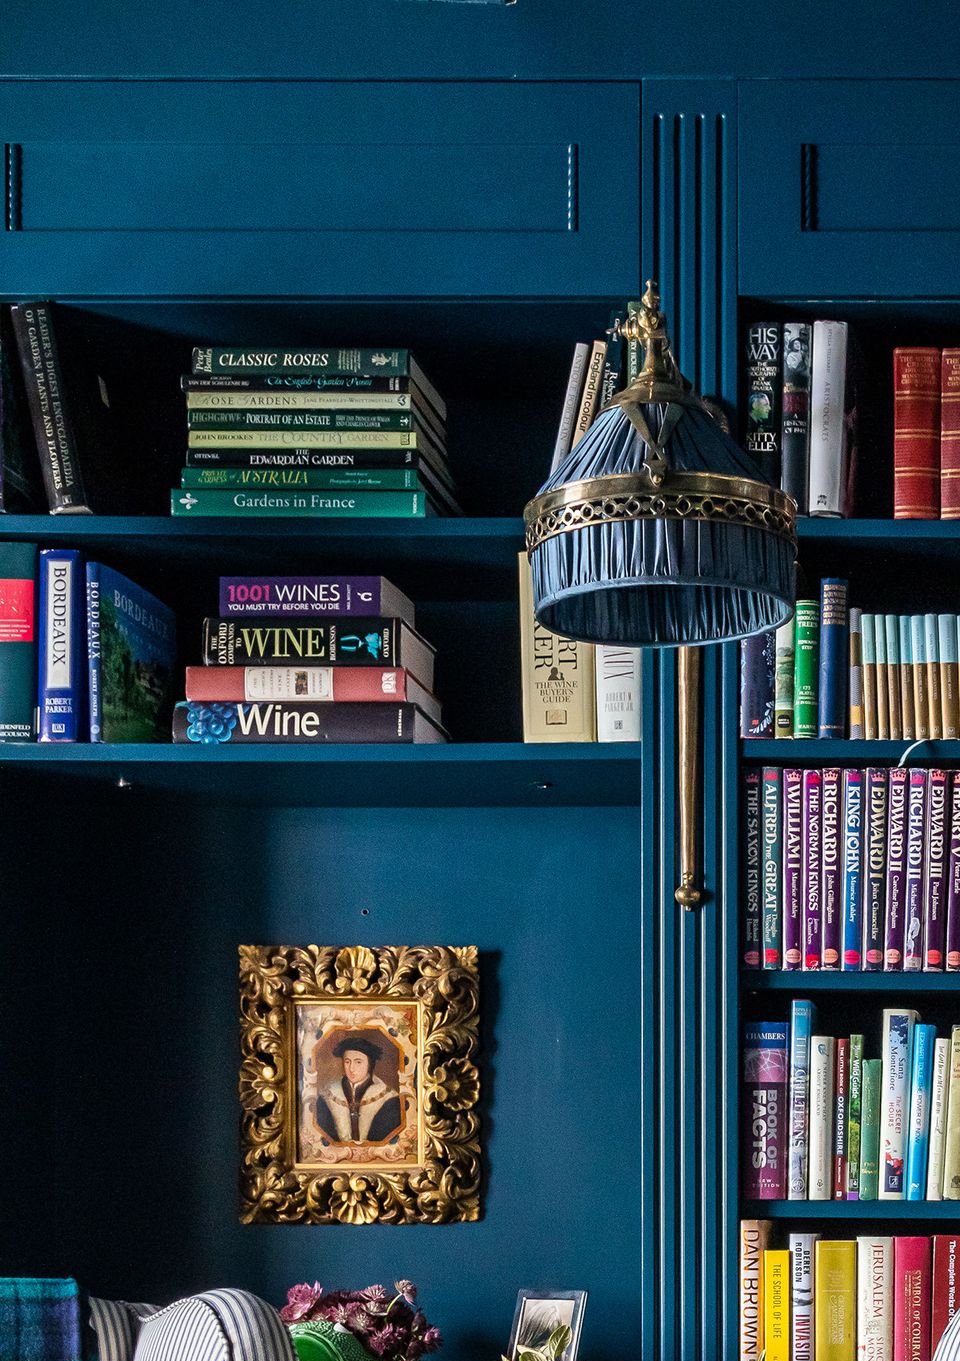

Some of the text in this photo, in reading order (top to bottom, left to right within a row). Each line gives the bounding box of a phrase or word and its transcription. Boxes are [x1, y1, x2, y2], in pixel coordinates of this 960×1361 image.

[746, 344, 780, 360] WAY
[749, 328, 778, 344] HIS
[219, 353, 278, 368] CLASSIC
[283, 353, 330, 368] ROSES
[25, 310, 63, 490] OF GARDEN PLANTS AND FLOWERS
[250, 456, 355, 466] EDWARDIAN GARDEN
[234, 494, 356, 509] Gardens in France
[228, 585, 270, 602] 1001
[275, 584, 341, 601] WINES
[228, 603, 341, 611] YOU MUST TRY BEFORE YOU DIE
[53, 567, 67, 666] BORDEAUX
[91, 581, 100, 659] BORDEAUX
[218, 623, 227, 665] OXFORD
[240, 627, 325, 657] WINE
[236, 703, 321, 737] Wine
[847, 786, 860, 872] KING JOHN
[890, 785, 904, 861] EDWARD
[910, 786, 924, 865] RICHARD
[930, 786, 944, 878] EDWARD III
[808, 787, 819, 911] THE NORMAN KINGS
[889, 1046, 899, 1092] Montefiore
[752, 1089, 767, 1169] FACTS
[766, 1089, 778, 1170] BOOK OF
[795, 1242, 803, 1284] ROBINSON
[803, 1250, 811, 1275] DEREK
[871, 1243, 884, 1319] JERUSALEM
[742, 1229, 760, 1355] DAN BROWN
[911, 1269, 922, 1307] SYMBOL
[913, 1309, 921, 1321] OF
